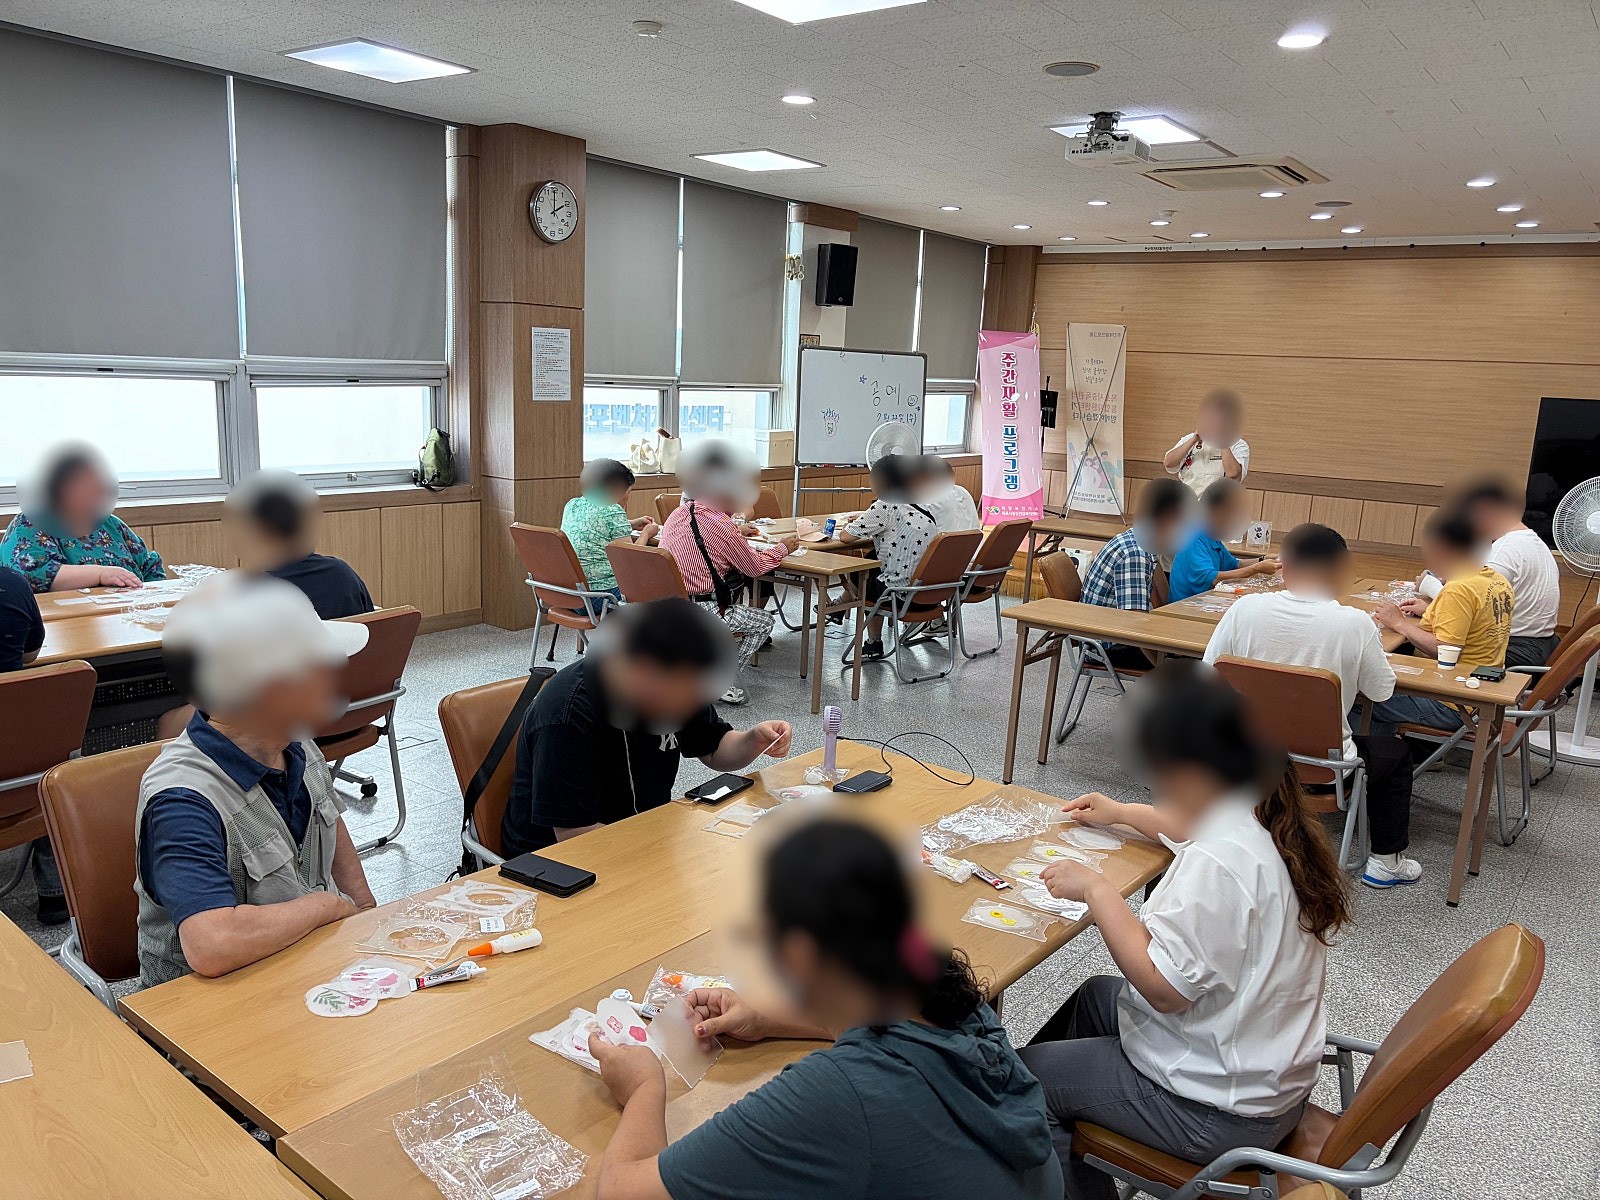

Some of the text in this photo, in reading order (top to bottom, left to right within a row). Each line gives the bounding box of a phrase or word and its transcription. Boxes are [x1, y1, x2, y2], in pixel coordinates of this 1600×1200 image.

[871, 380, 901, 407] 공예
[1001, 352, 1017, 418] 주간재활
[1003, 425, 1019, 490] 프로그램
